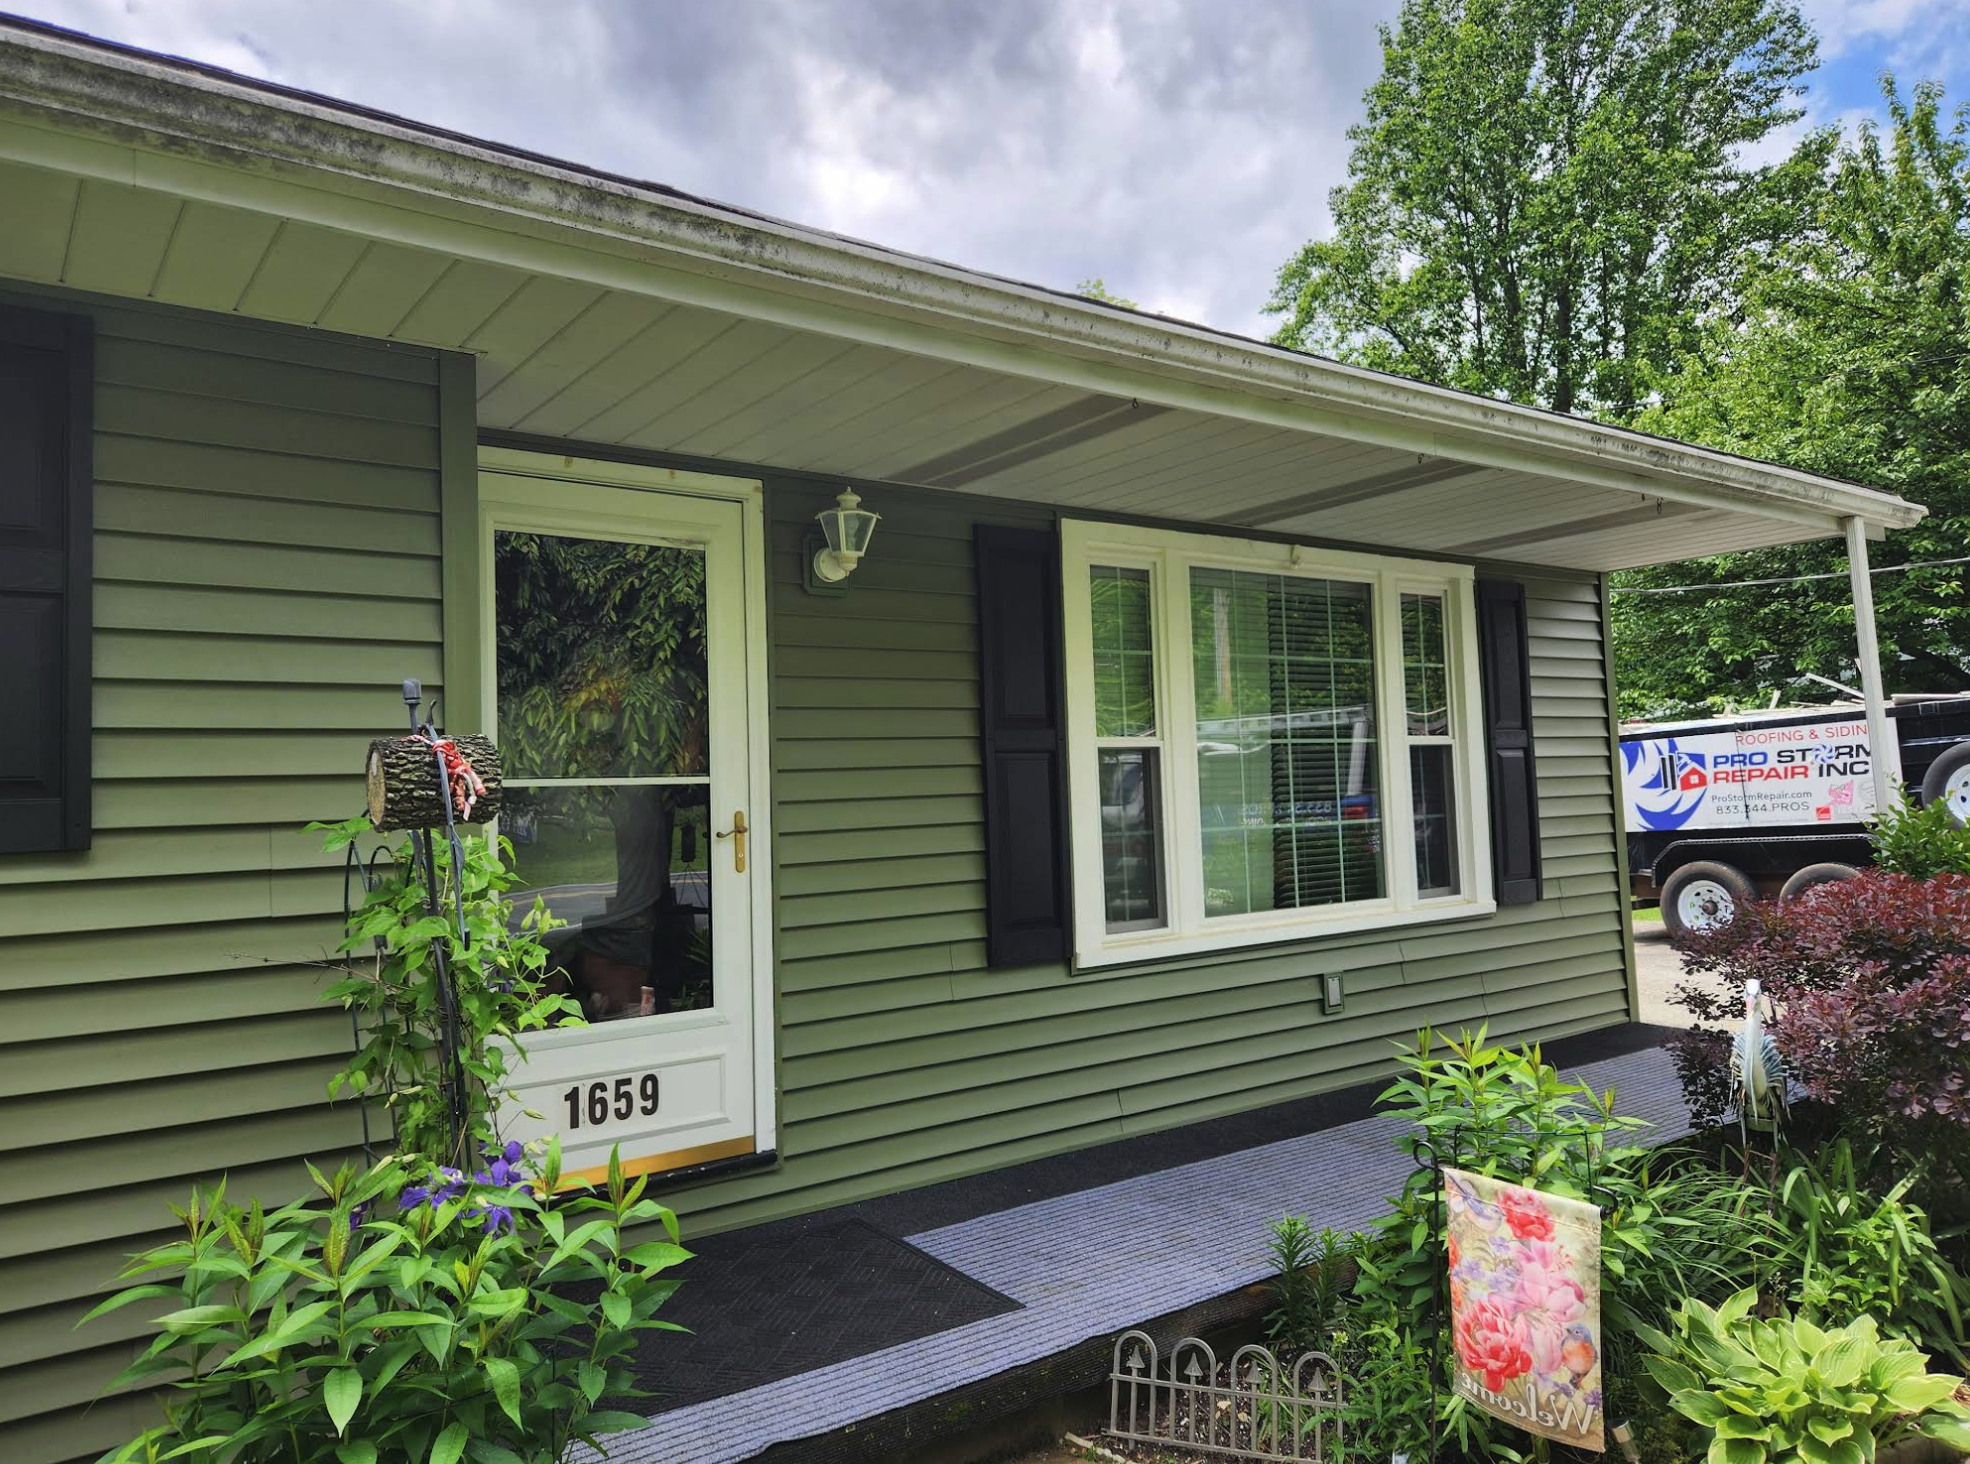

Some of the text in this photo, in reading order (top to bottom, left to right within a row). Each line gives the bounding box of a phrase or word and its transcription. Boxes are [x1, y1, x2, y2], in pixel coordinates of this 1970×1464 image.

[1736, 724, 1868, 745] ROOFING & SIDIN
[1713, 751, 1768, 768] PRO
[1713, 761, 1869, 784] REPAIR INC
[564, 1073, 660, 1129] 1659
